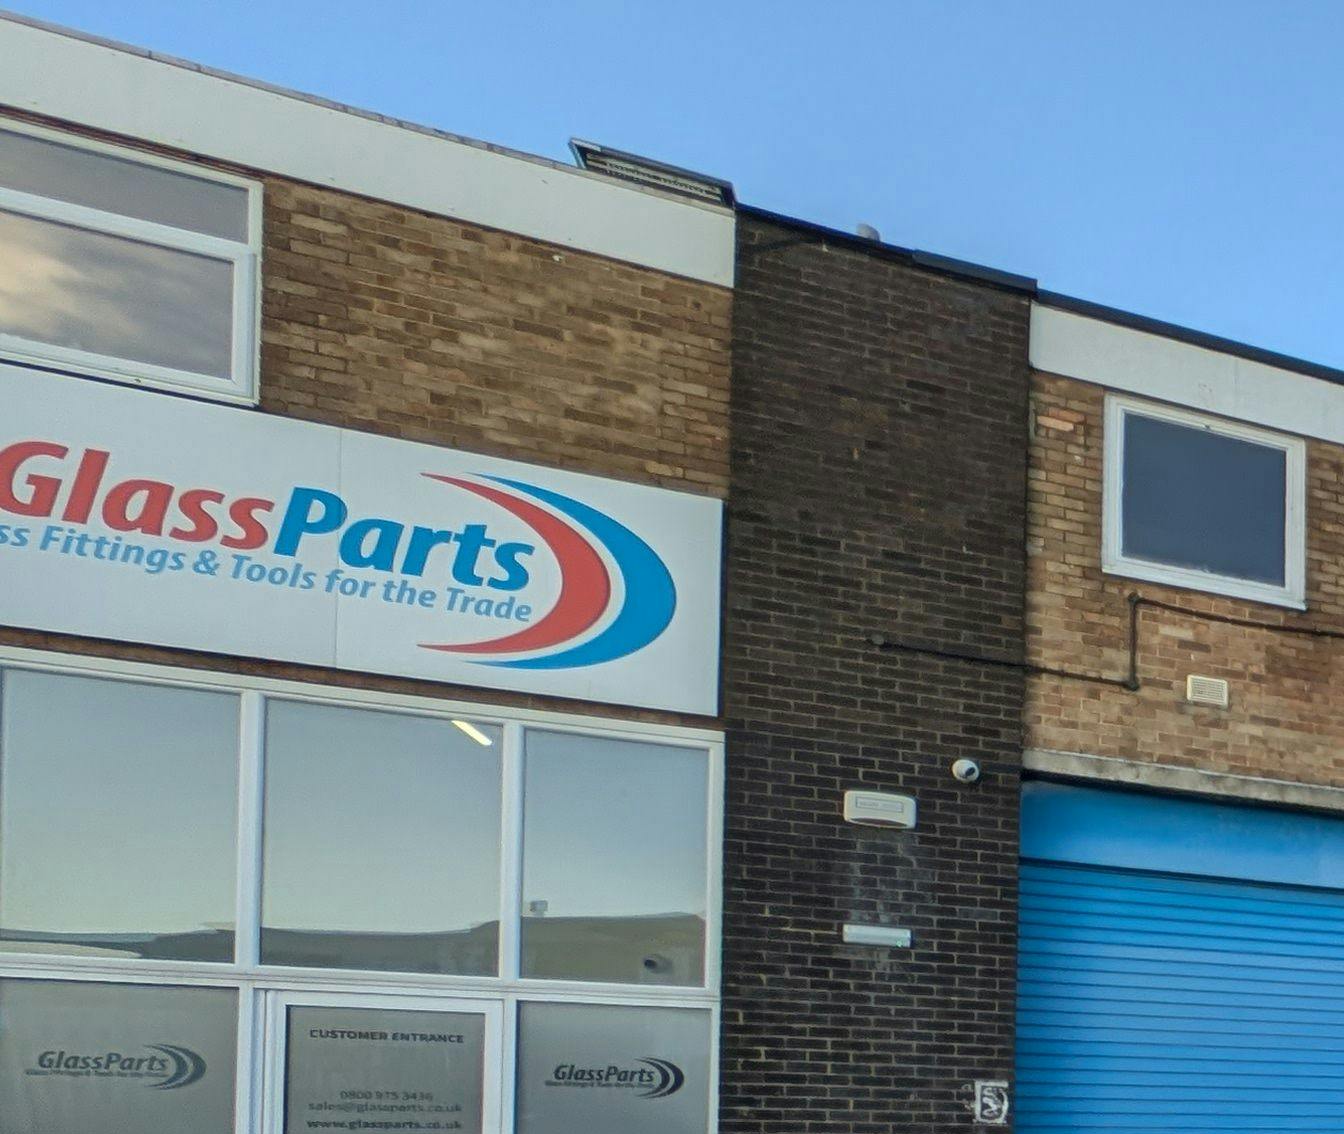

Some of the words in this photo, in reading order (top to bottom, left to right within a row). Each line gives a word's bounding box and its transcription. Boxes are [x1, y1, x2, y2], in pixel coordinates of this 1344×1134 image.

[0, 440, 535, 591] GlassParts
[39, 525, 187, 575] Fittings
[192, 550, 220, 576] &
[231, 553, 317, 590] Tools
[324, 568, 376, 599] for
[382, 578, 437, 608] the
[446, 587, 532, 622] Trade
[309, 1029, 388, 1041] CUSTOMER
[391, 1032, 464, 1044] ENTRANCE
[38, 1050, 170, 1072] GlassParts
[553, 1064, 655, 1083] GlassParts
